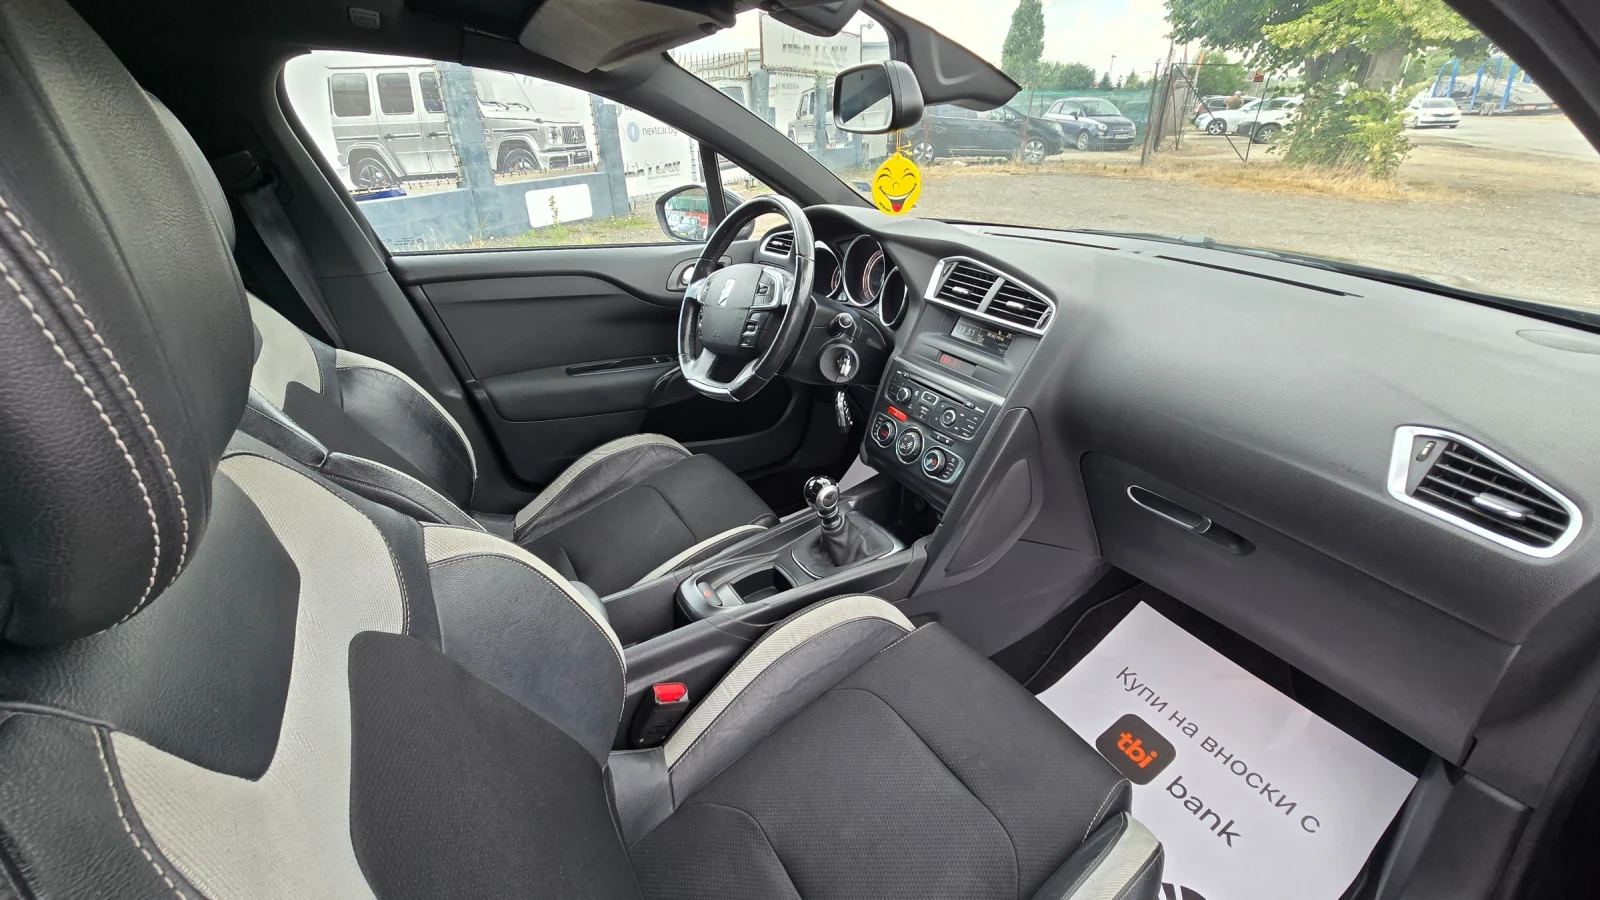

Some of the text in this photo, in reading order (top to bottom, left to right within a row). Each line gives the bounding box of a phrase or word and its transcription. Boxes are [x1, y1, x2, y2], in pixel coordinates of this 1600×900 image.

[1115, 666, 1321, 834] Купи на вноски с
[1116, 732, 1242, 848] tbi bank
